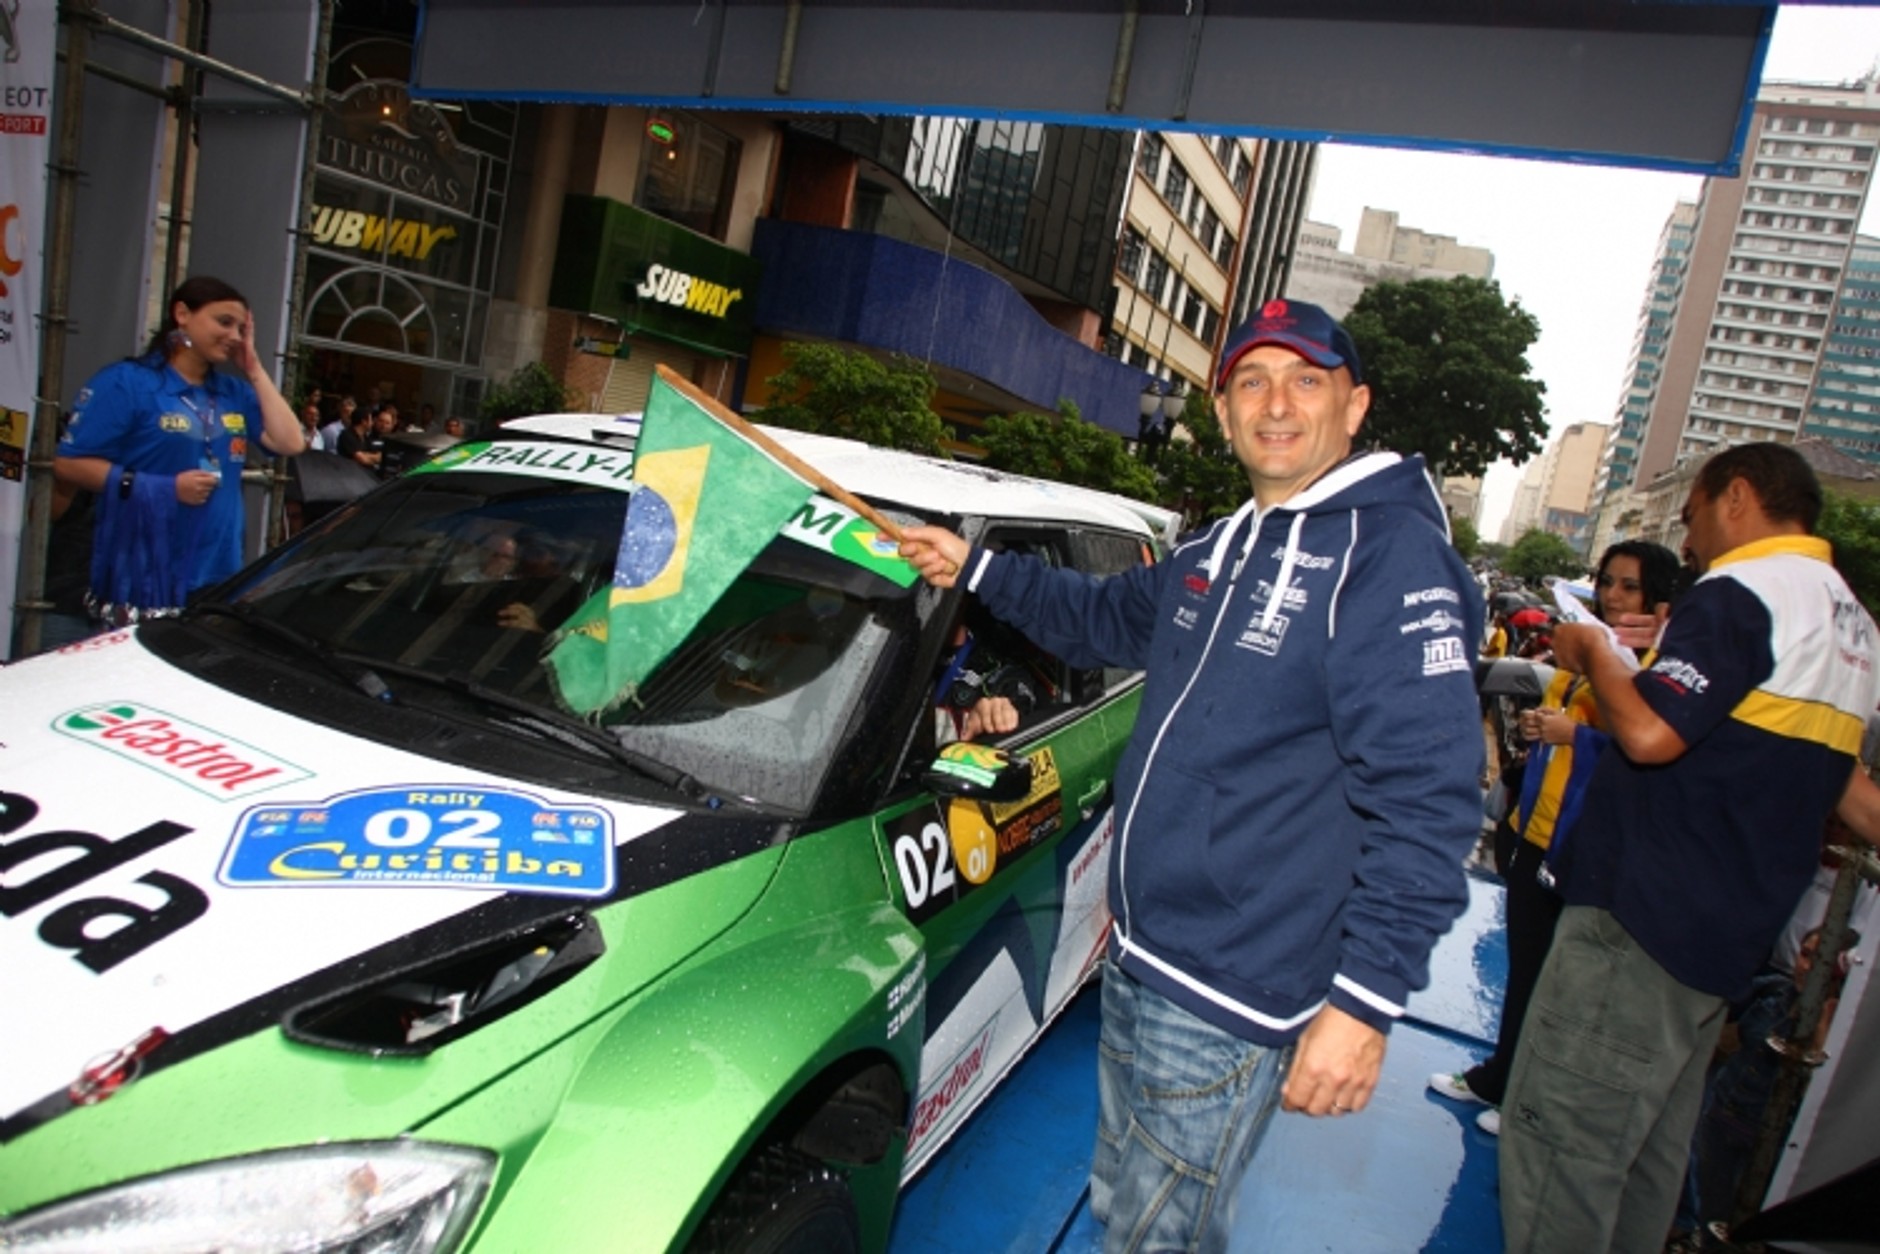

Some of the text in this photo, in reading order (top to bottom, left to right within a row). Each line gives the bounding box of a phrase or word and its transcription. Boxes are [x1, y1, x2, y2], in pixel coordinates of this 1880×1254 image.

[326, 135, 460, 204] TIJUCAS
[311, 203, 457, 260] UBWAY
[636, 263, 743, 317] SUBWAY
[101, 719, 284, 790] Castrol
[407, 791, 485, 807] Rally
[363, 808, 503, 849] 02
[269, 841, 583, 880] Curitiba
[895, 822, 955, 909] 02
